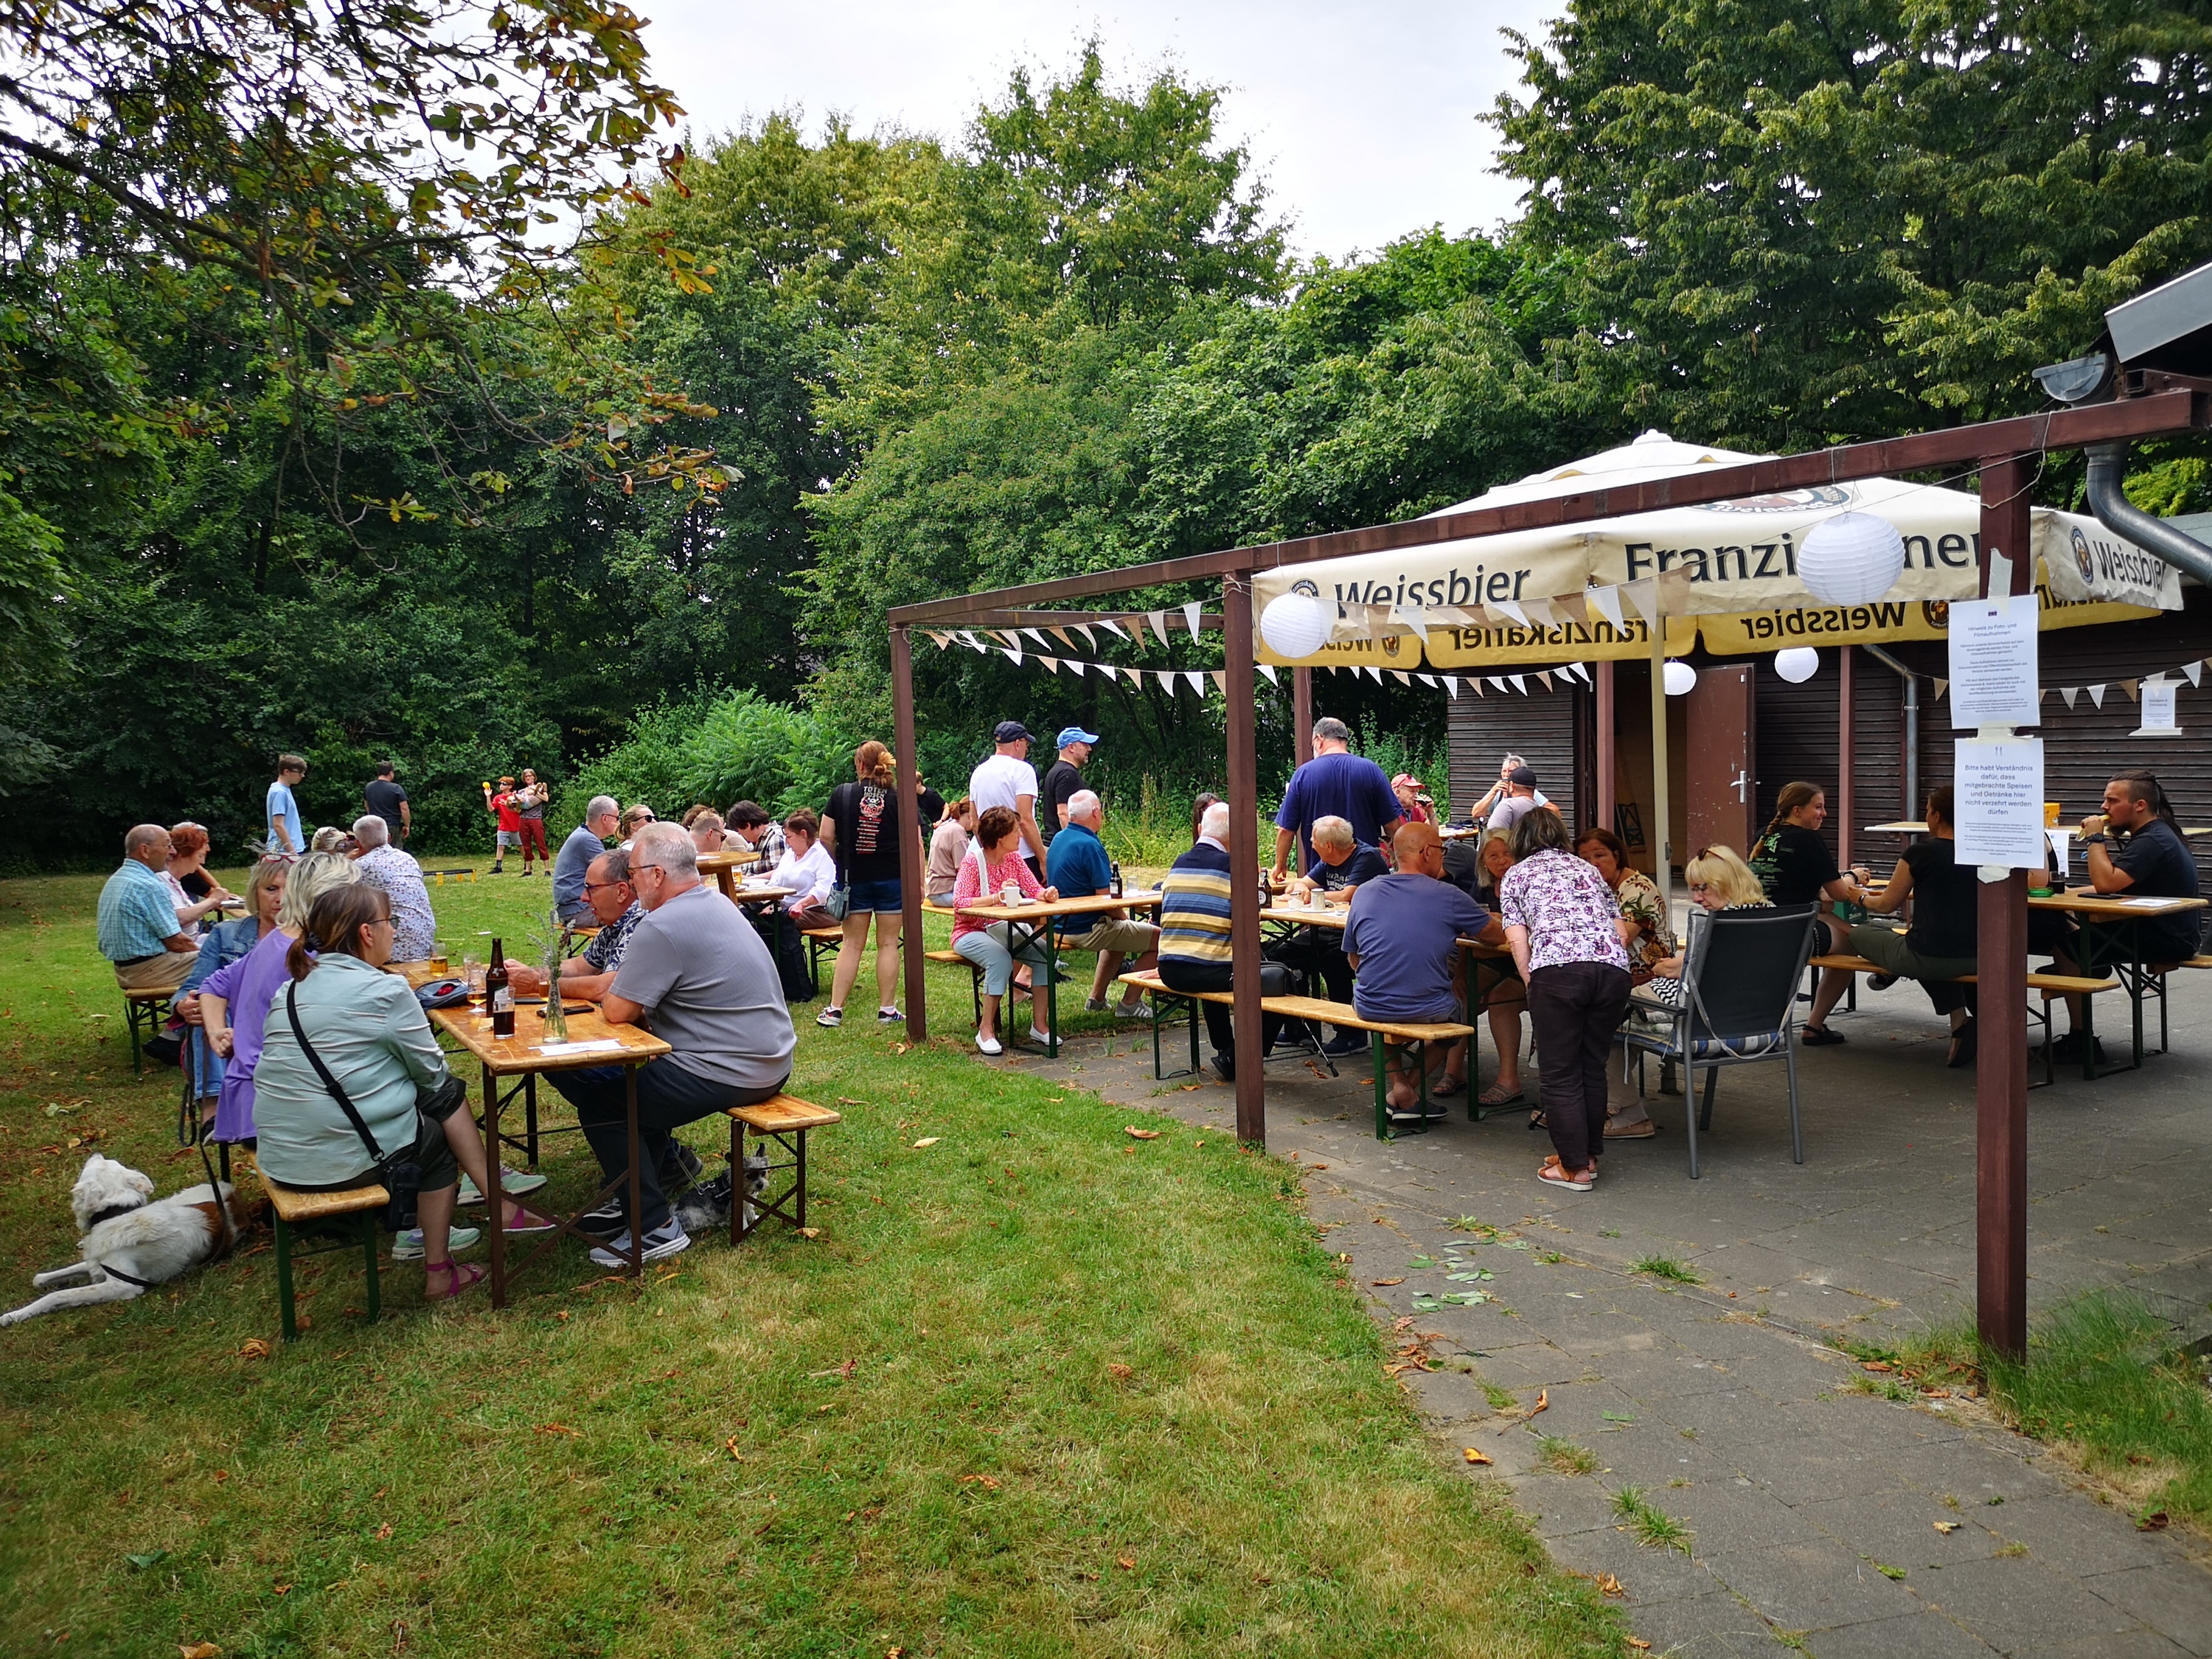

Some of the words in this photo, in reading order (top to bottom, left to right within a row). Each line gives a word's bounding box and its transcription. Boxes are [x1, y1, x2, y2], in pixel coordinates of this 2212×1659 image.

[1335, 564, 1531, 620] Weissbier
[2093, 540, 2166, 592] Weissbier
[863, 786, 888, 795] TOTEN
